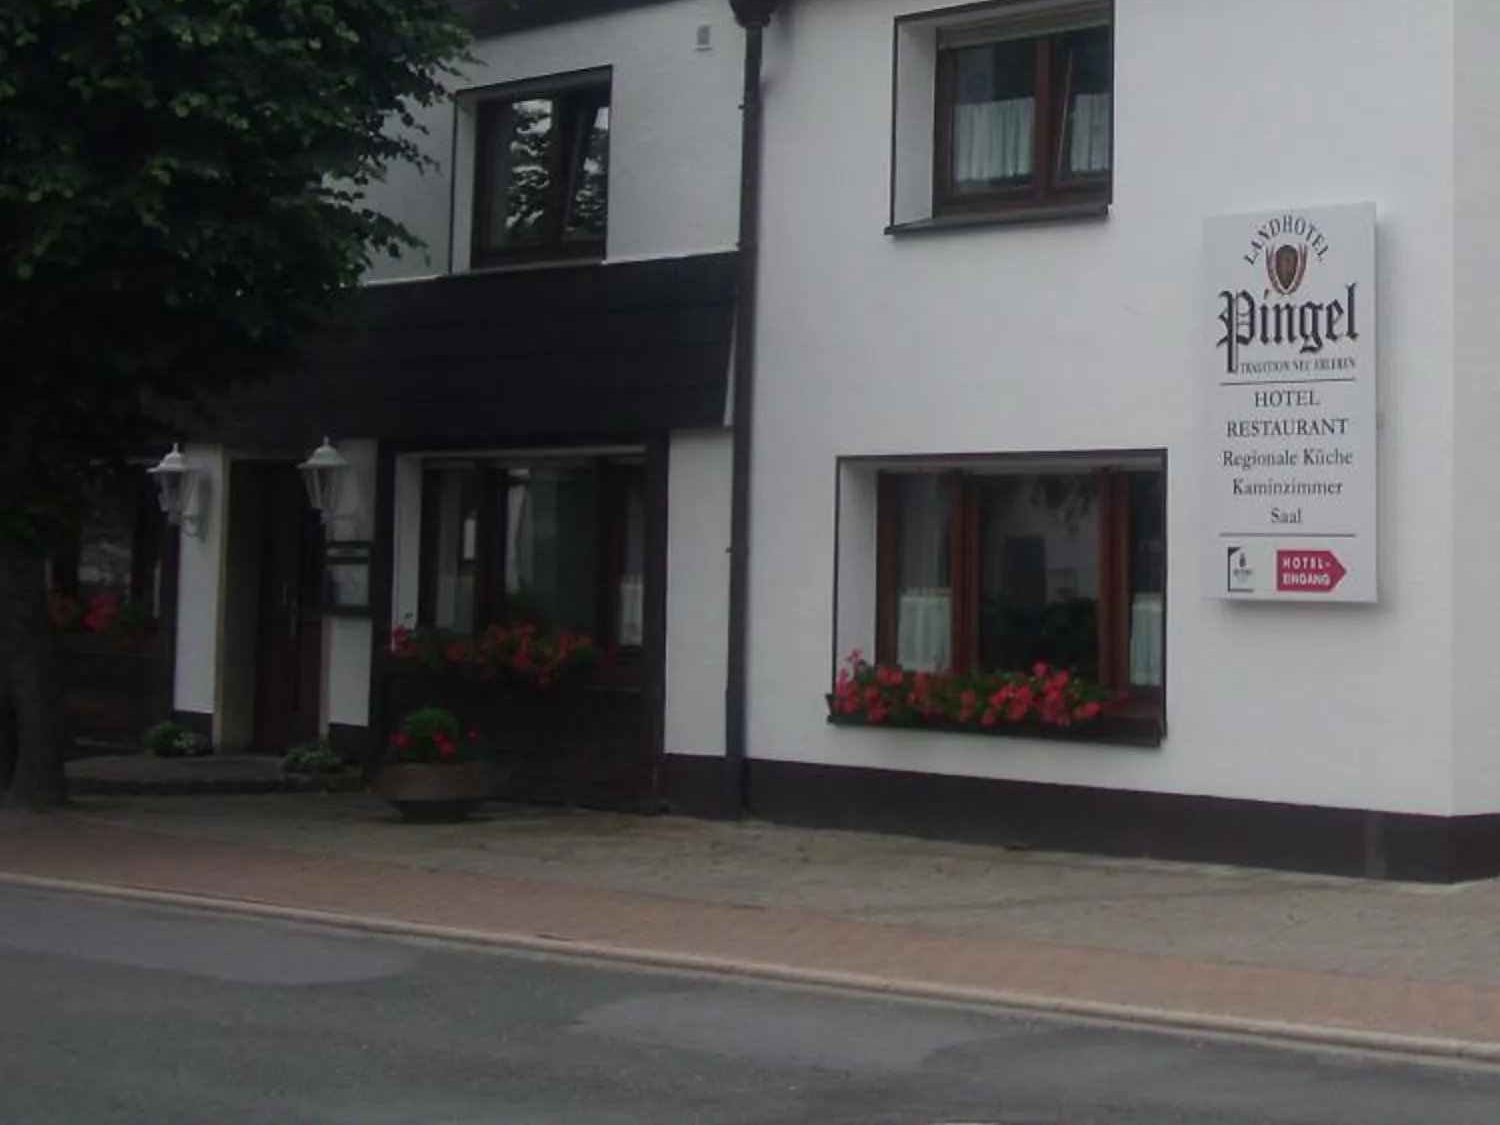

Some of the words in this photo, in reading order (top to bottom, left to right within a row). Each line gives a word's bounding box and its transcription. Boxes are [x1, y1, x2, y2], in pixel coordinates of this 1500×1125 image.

[1243, 214, 1329, 265] LANDHOTEL
[1216, 282, 1359, 373] Pingel
[1254, 389, 1320, 407] HOTEL
[1227, 418, 1349, 438] RESTAURANT
[1223, 449, 1298, 470] Regionale
[1303, 448, 1353, 467] Küche
[1233, 478, 1343, 496] Kaminzimmer
[1271, 507, 1303, 524] Saal
